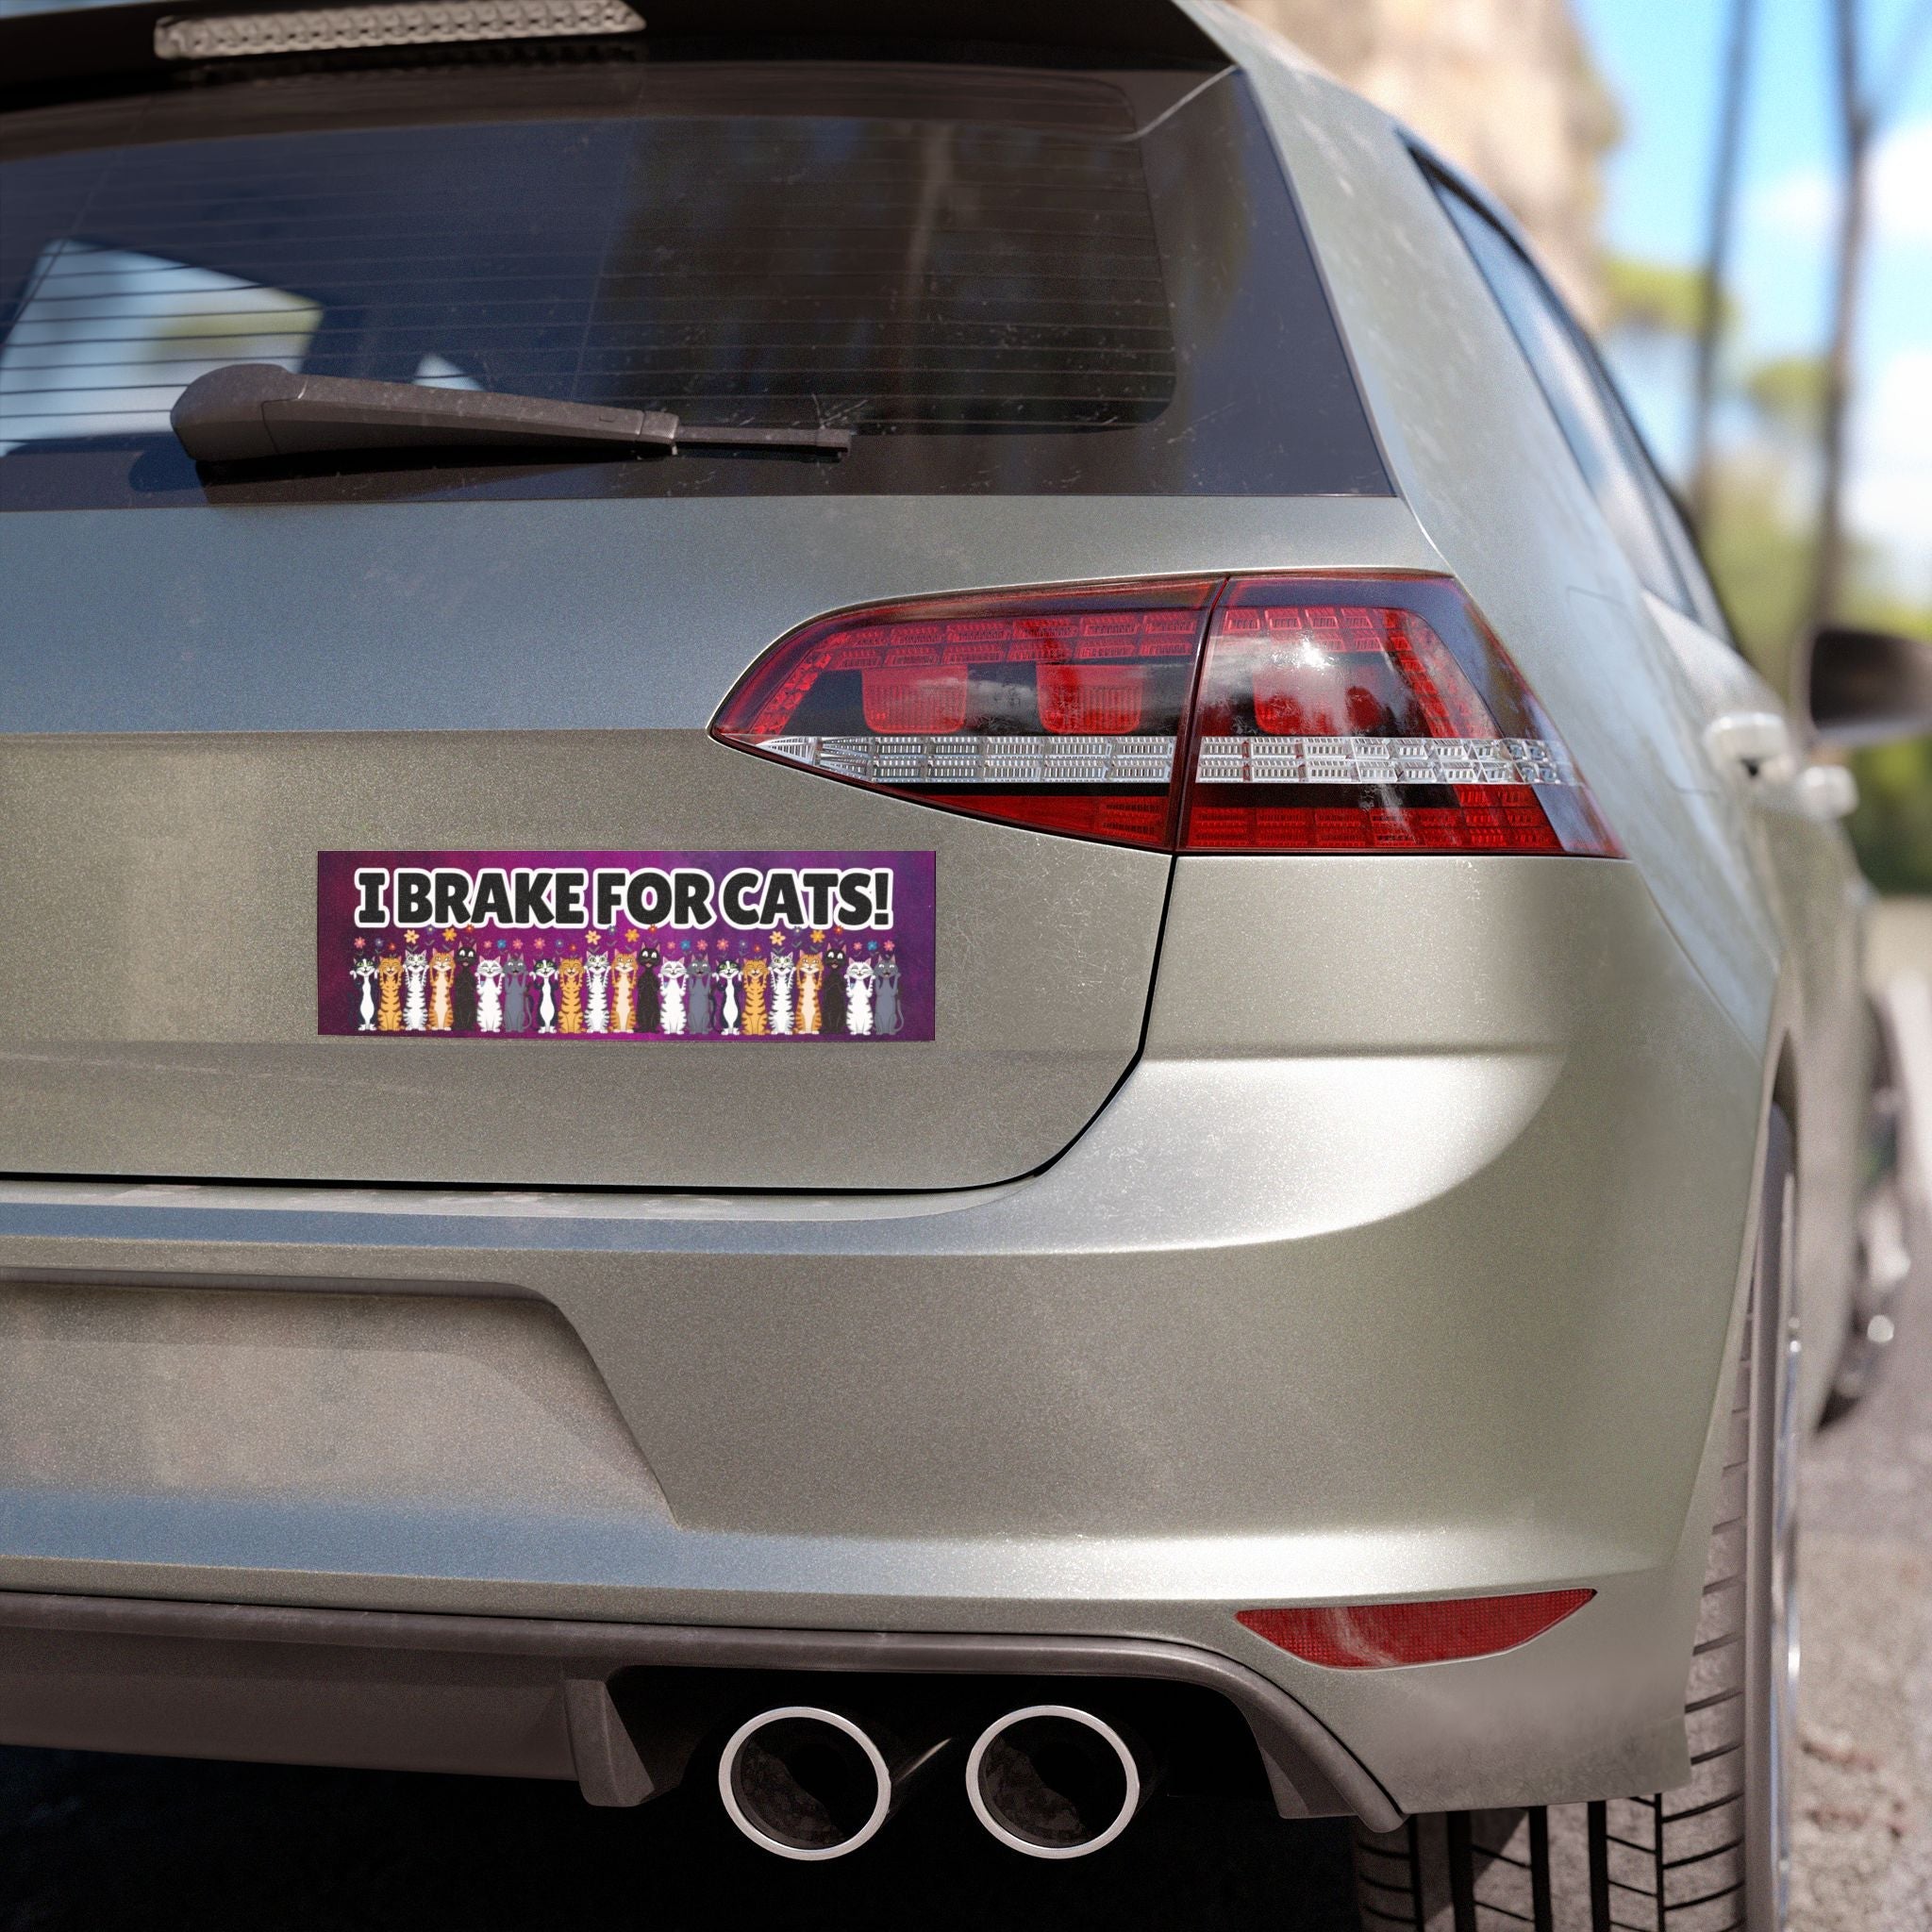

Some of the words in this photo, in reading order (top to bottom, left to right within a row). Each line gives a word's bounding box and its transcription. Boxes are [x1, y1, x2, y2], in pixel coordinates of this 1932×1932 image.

[357, 871, 388, 925] I
[397, 871, 586, 926] BRAKE
[596, 871, 716, 926] FOR
[723, 871, 892, 928] CATS!
